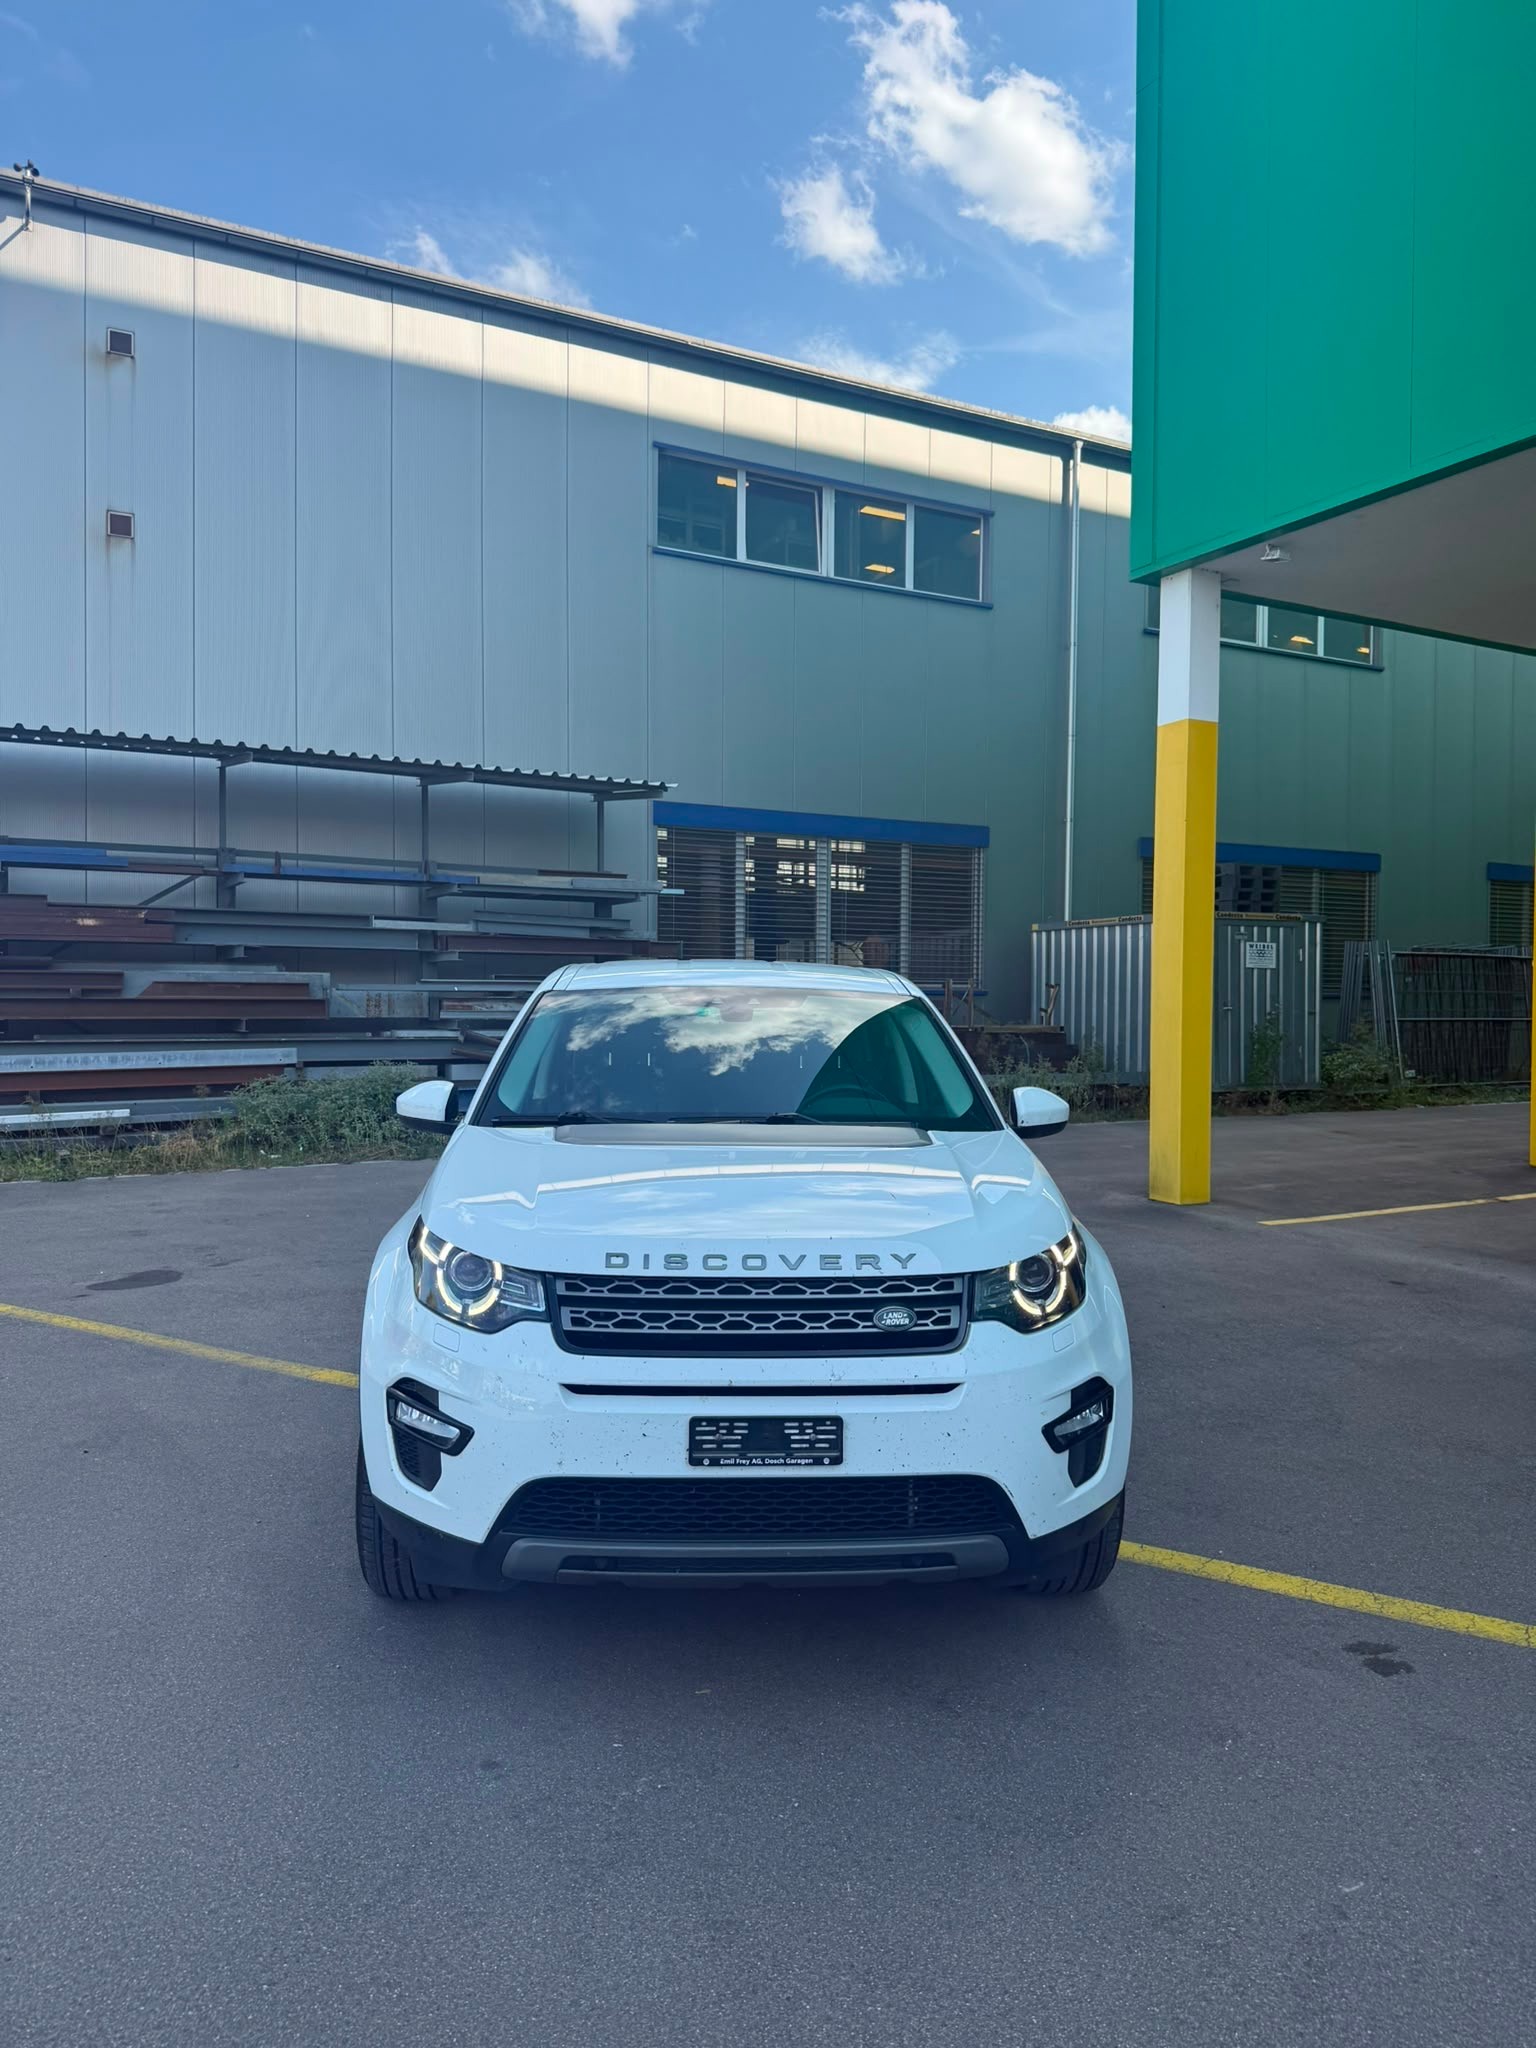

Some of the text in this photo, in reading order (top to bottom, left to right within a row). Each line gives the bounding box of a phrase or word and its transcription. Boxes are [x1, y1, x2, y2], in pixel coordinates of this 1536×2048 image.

[604, 1252, 917, 1271] DISCOVERY
[736, 1458, 750, 1466] Frey
[765, 1457, 785, 1465] Dosch
[786, 1457, 813, 1466] Garagen
